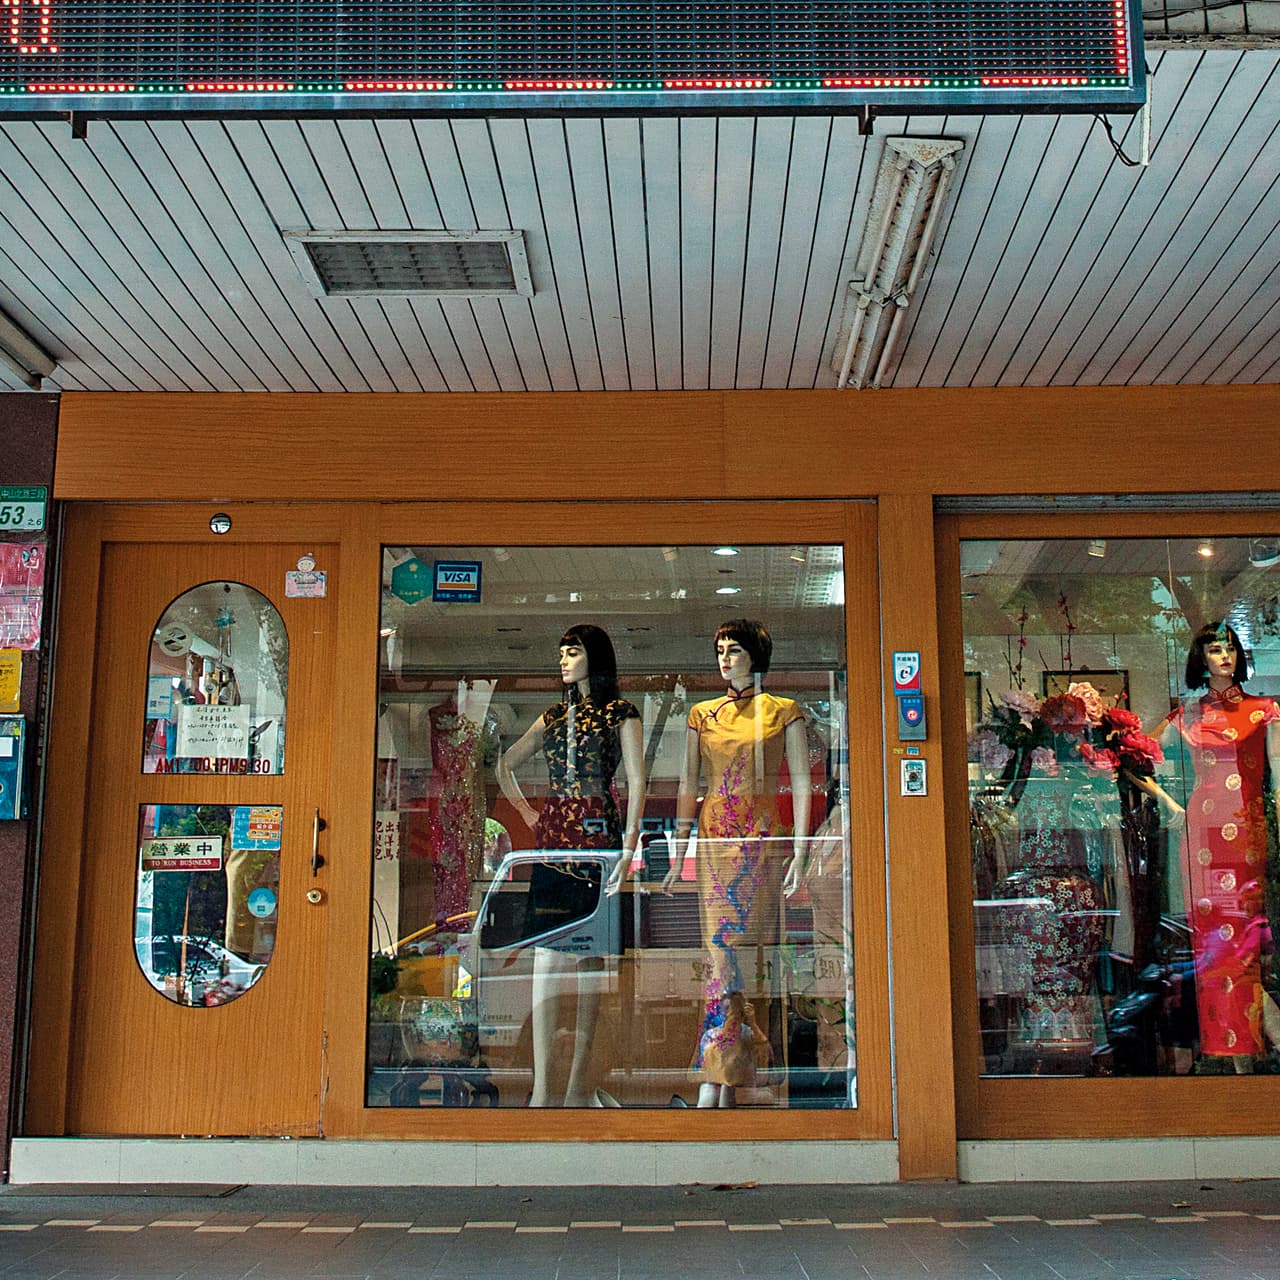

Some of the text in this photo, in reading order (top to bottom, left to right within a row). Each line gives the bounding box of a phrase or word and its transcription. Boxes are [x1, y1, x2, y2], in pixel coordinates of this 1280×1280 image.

[0, 506, 25, 525] 53
[444, 572, 471, 583] VISA
[150, 841, 213, 856] 營業中
